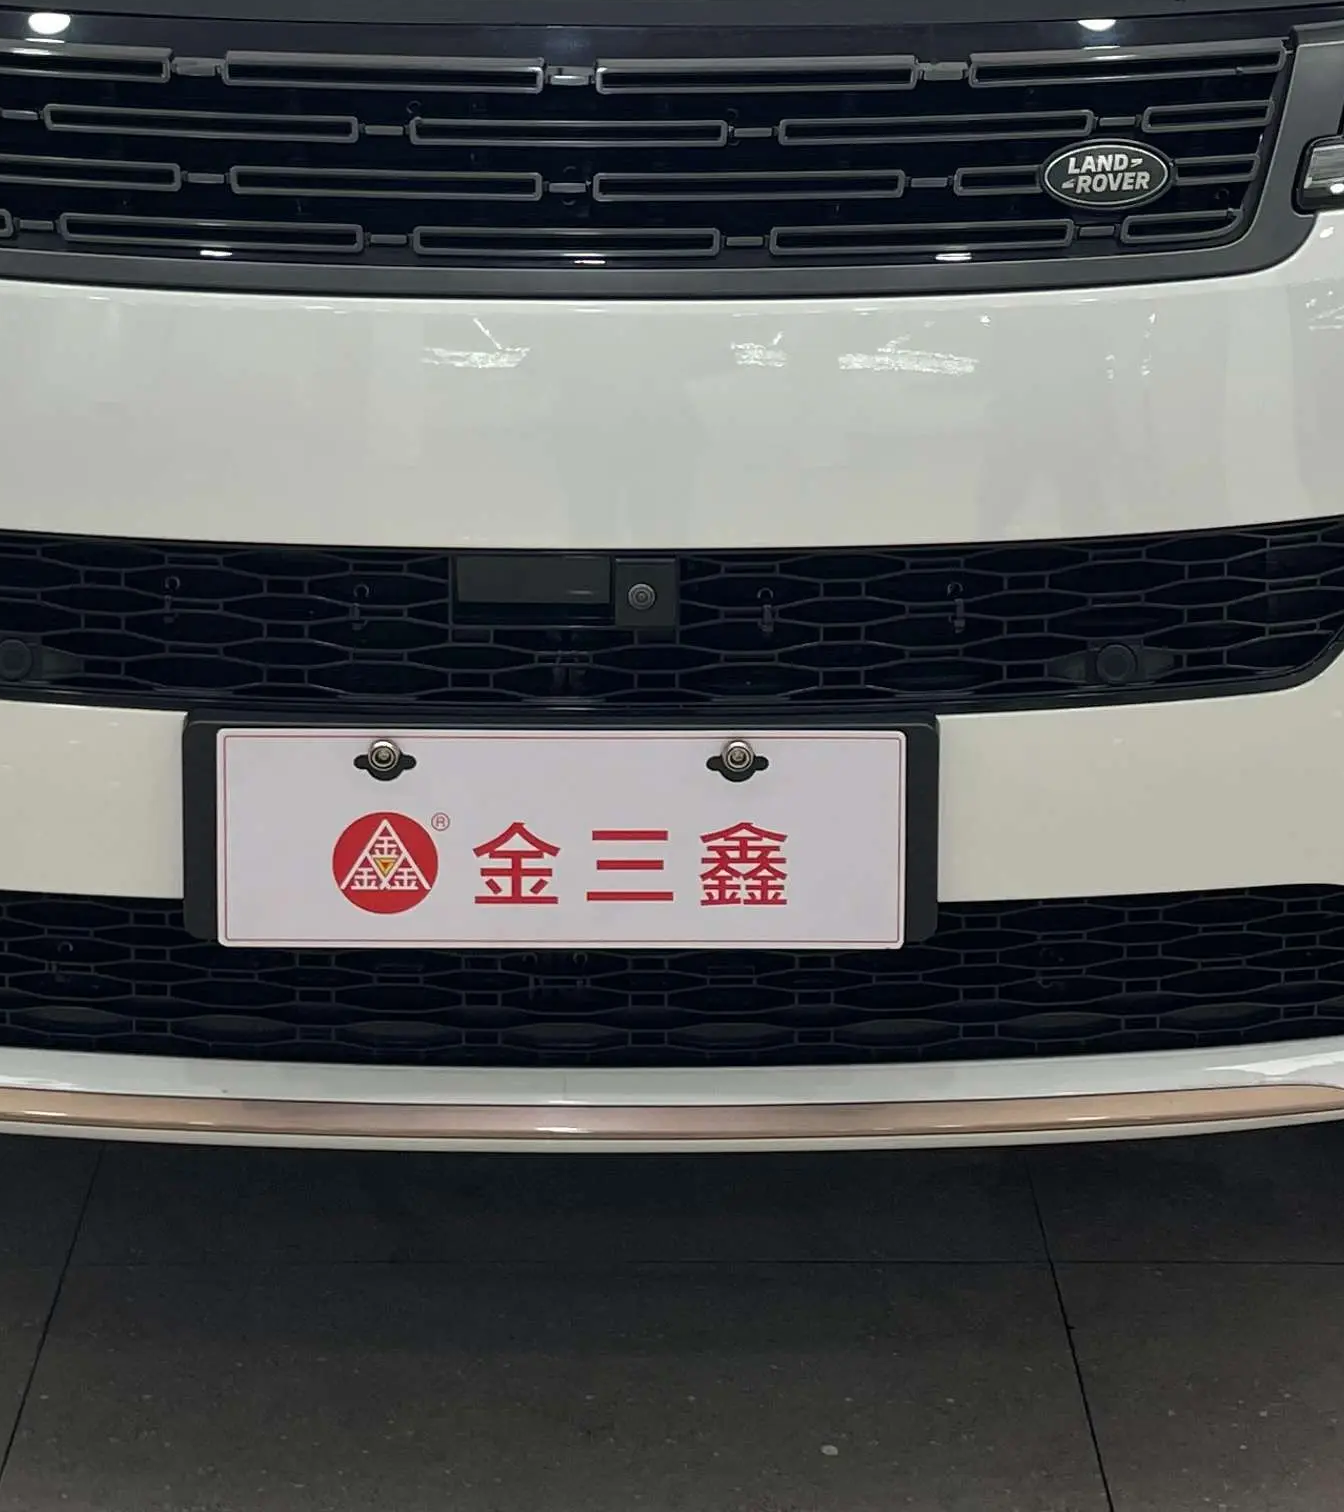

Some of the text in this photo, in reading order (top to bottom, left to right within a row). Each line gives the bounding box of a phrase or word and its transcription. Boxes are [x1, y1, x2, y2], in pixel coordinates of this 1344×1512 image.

[1067, 154, 1129, 175] LAND
[1076, 171, 1151, 194] ROVER
[473, 821, 788, 907] 金三鑫
